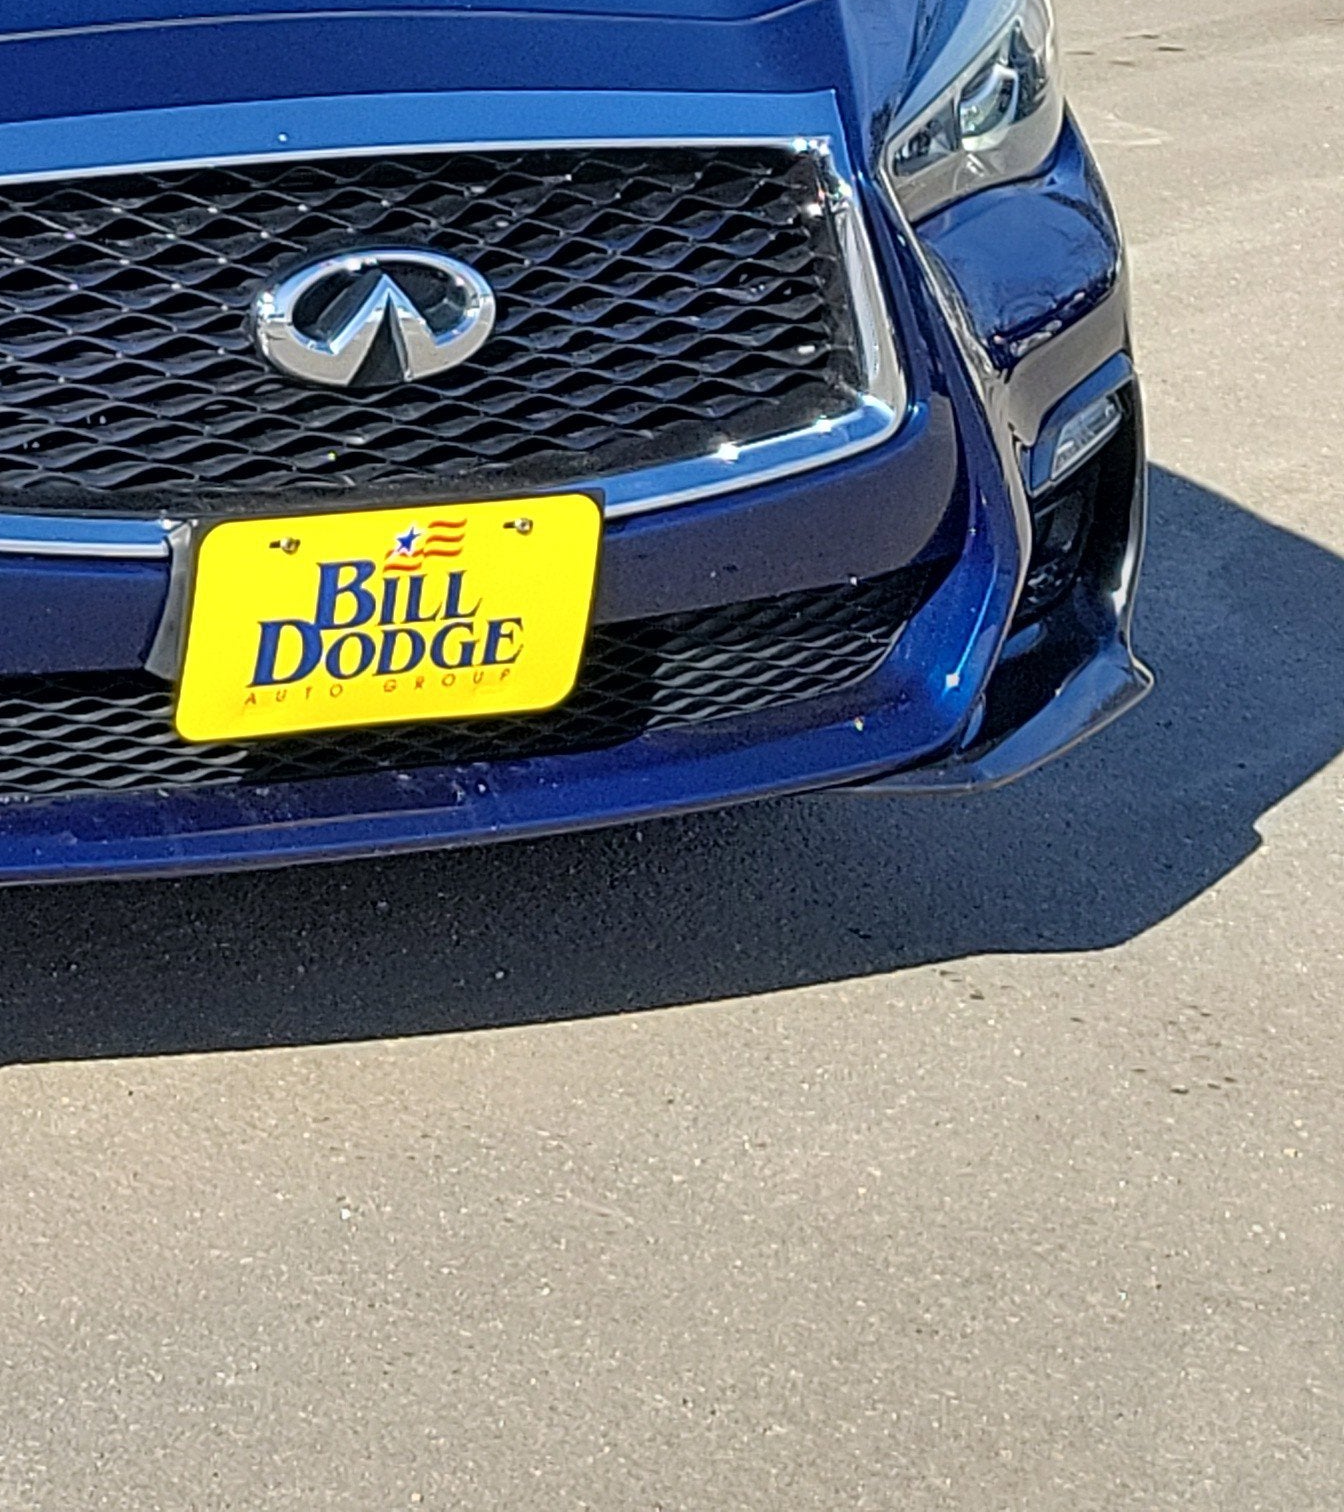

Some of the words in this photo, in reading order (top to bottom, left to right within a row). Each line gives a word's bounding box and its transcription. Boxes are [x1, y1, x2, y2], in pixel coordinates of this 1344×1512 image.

[315, 558, 483, 630] BILL
[243, 683, 344, 706] AUTO
[382, 668, 513, 694] GROUP
[247, 616, 524, 688] DODGE
